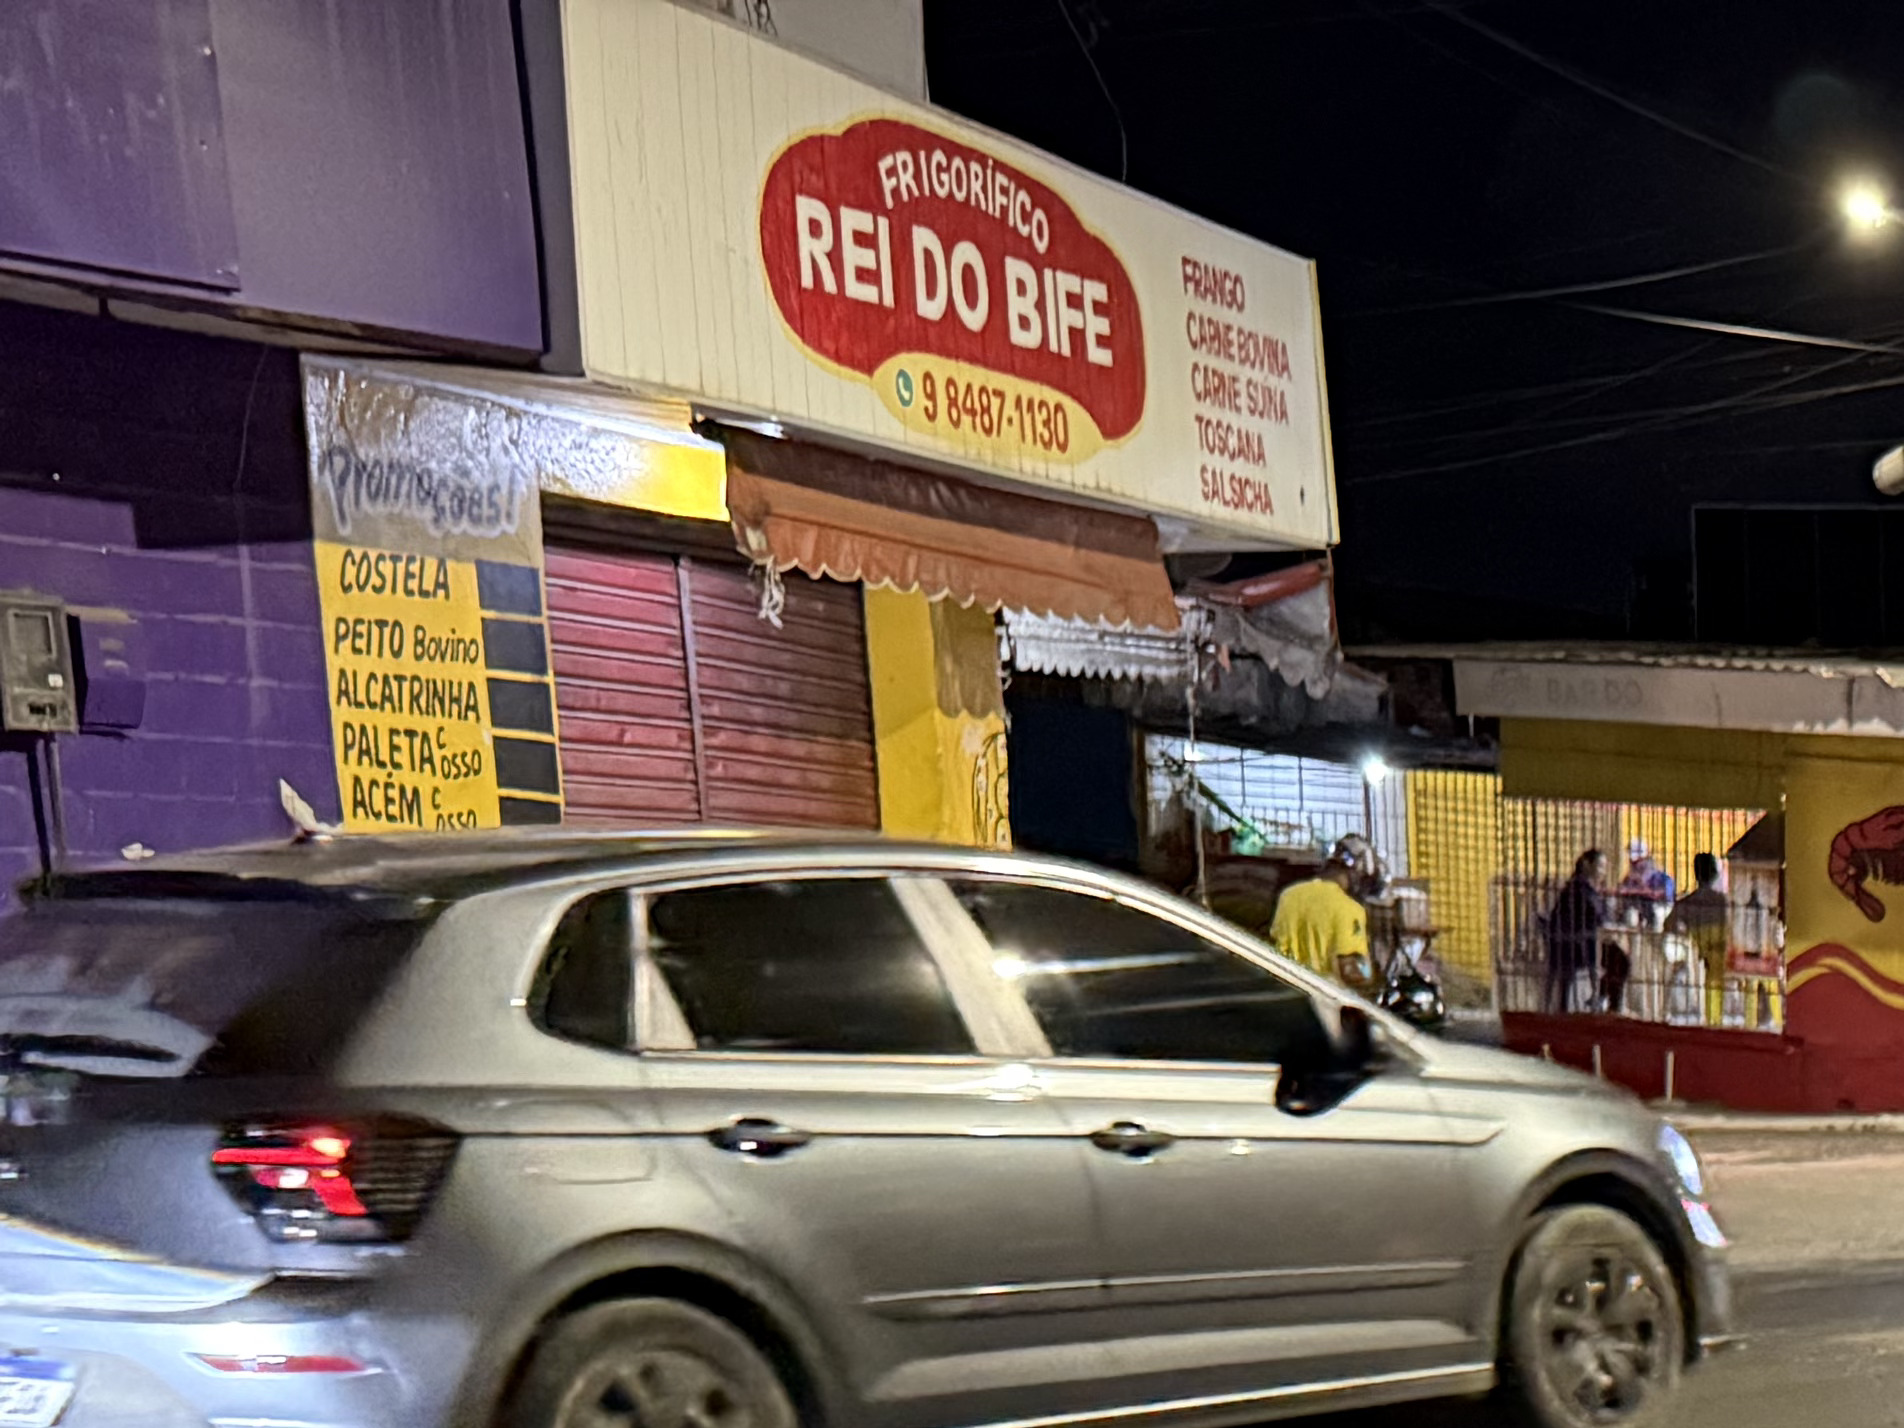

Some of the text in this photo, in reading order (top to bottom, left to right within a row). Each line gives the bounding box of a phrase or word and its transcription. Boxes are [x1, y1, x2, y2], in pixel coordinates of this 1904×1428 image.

[878, 149, 1050, 254] FRIGORÍFICO
[795, 195, 1114, 368] REI DO BIFE
[1181, 256, 1246, 313] FRANGO
[1186, 311, 1292, 381] CARNE BOVINA
[921, 370, 1070, 455] 9 8487-1130
[1191, 362, 1242, 414] CARNE
[1194, 413, 1267, 467] TOSCANA
[1200, 463, 1274, 516] SALSICHA
[340, 549, 450, 600] COSTELA
[334, 616, 479, 665] PEITO Bovino
[336, 668, 481, 725] ALCATRINHA
[342, 721, 437, 777] PALETA
[352, 771, 423, 828] ACÉM
